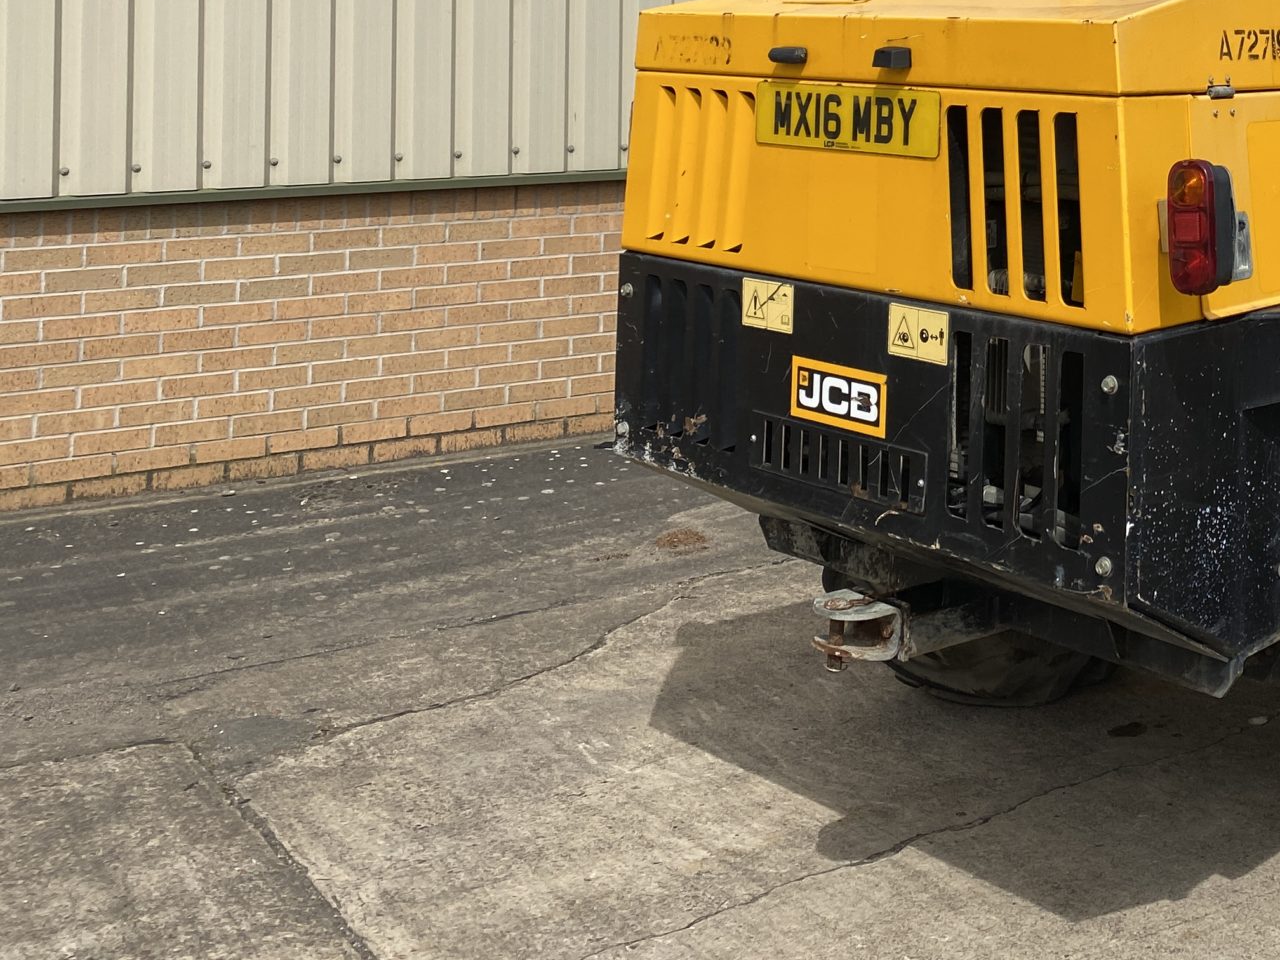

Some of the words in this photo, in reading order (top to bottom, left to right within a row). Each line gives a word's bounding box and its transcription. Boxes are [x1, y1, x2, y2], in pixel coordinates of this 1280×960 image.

[773, 91, 842, 139] MX16
[852, 96, 917, 146] MBY
[798, 373, 878, 422] JCB
